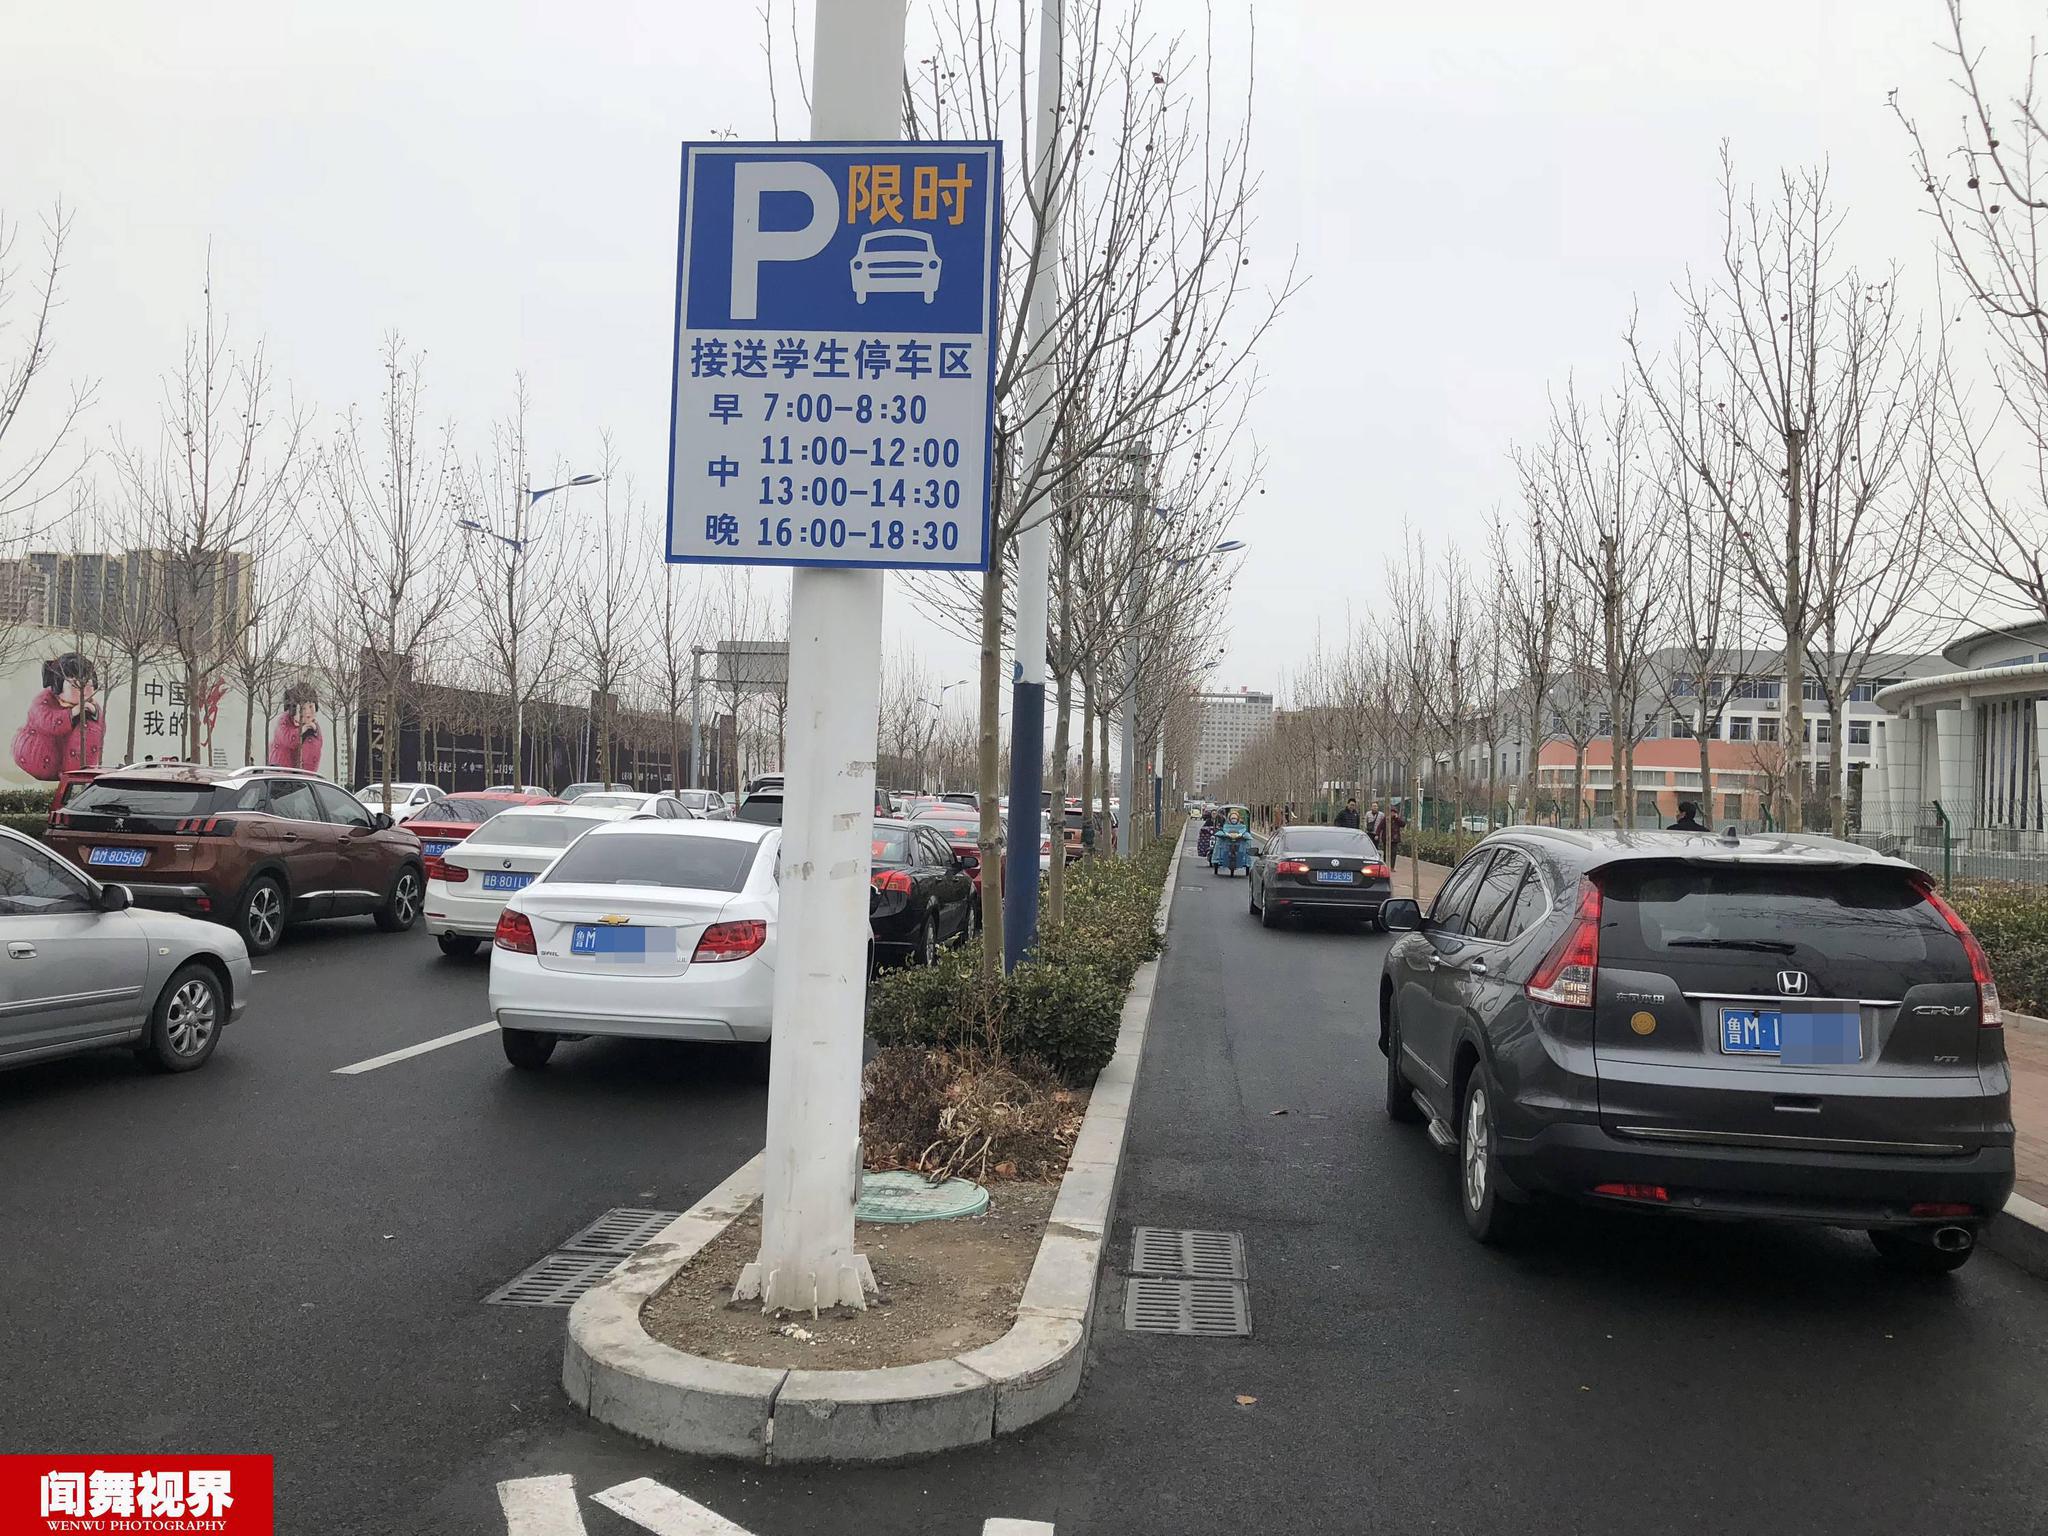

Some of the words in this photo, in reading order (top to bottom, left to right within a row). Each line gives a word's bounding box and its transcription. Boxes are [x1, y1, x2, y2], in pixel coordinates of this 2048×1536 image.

[847, 163, 973, 226] 限时
[730, 161, 840, 320] P
[690, 337, 973, 380] 接送学生停车区
[708, 394, 743, 425] 早
[763, 393, 927, 424] 7:00-8:30
[760, 436, 960, 468] 11:00-12:00
[708, 455, 740, 487] 中
[758, 476, 961, 509] 13:00-14:30
[705, 513, 739, 546] 晚
[757, 517, 959, 550] 16:00-18:30
